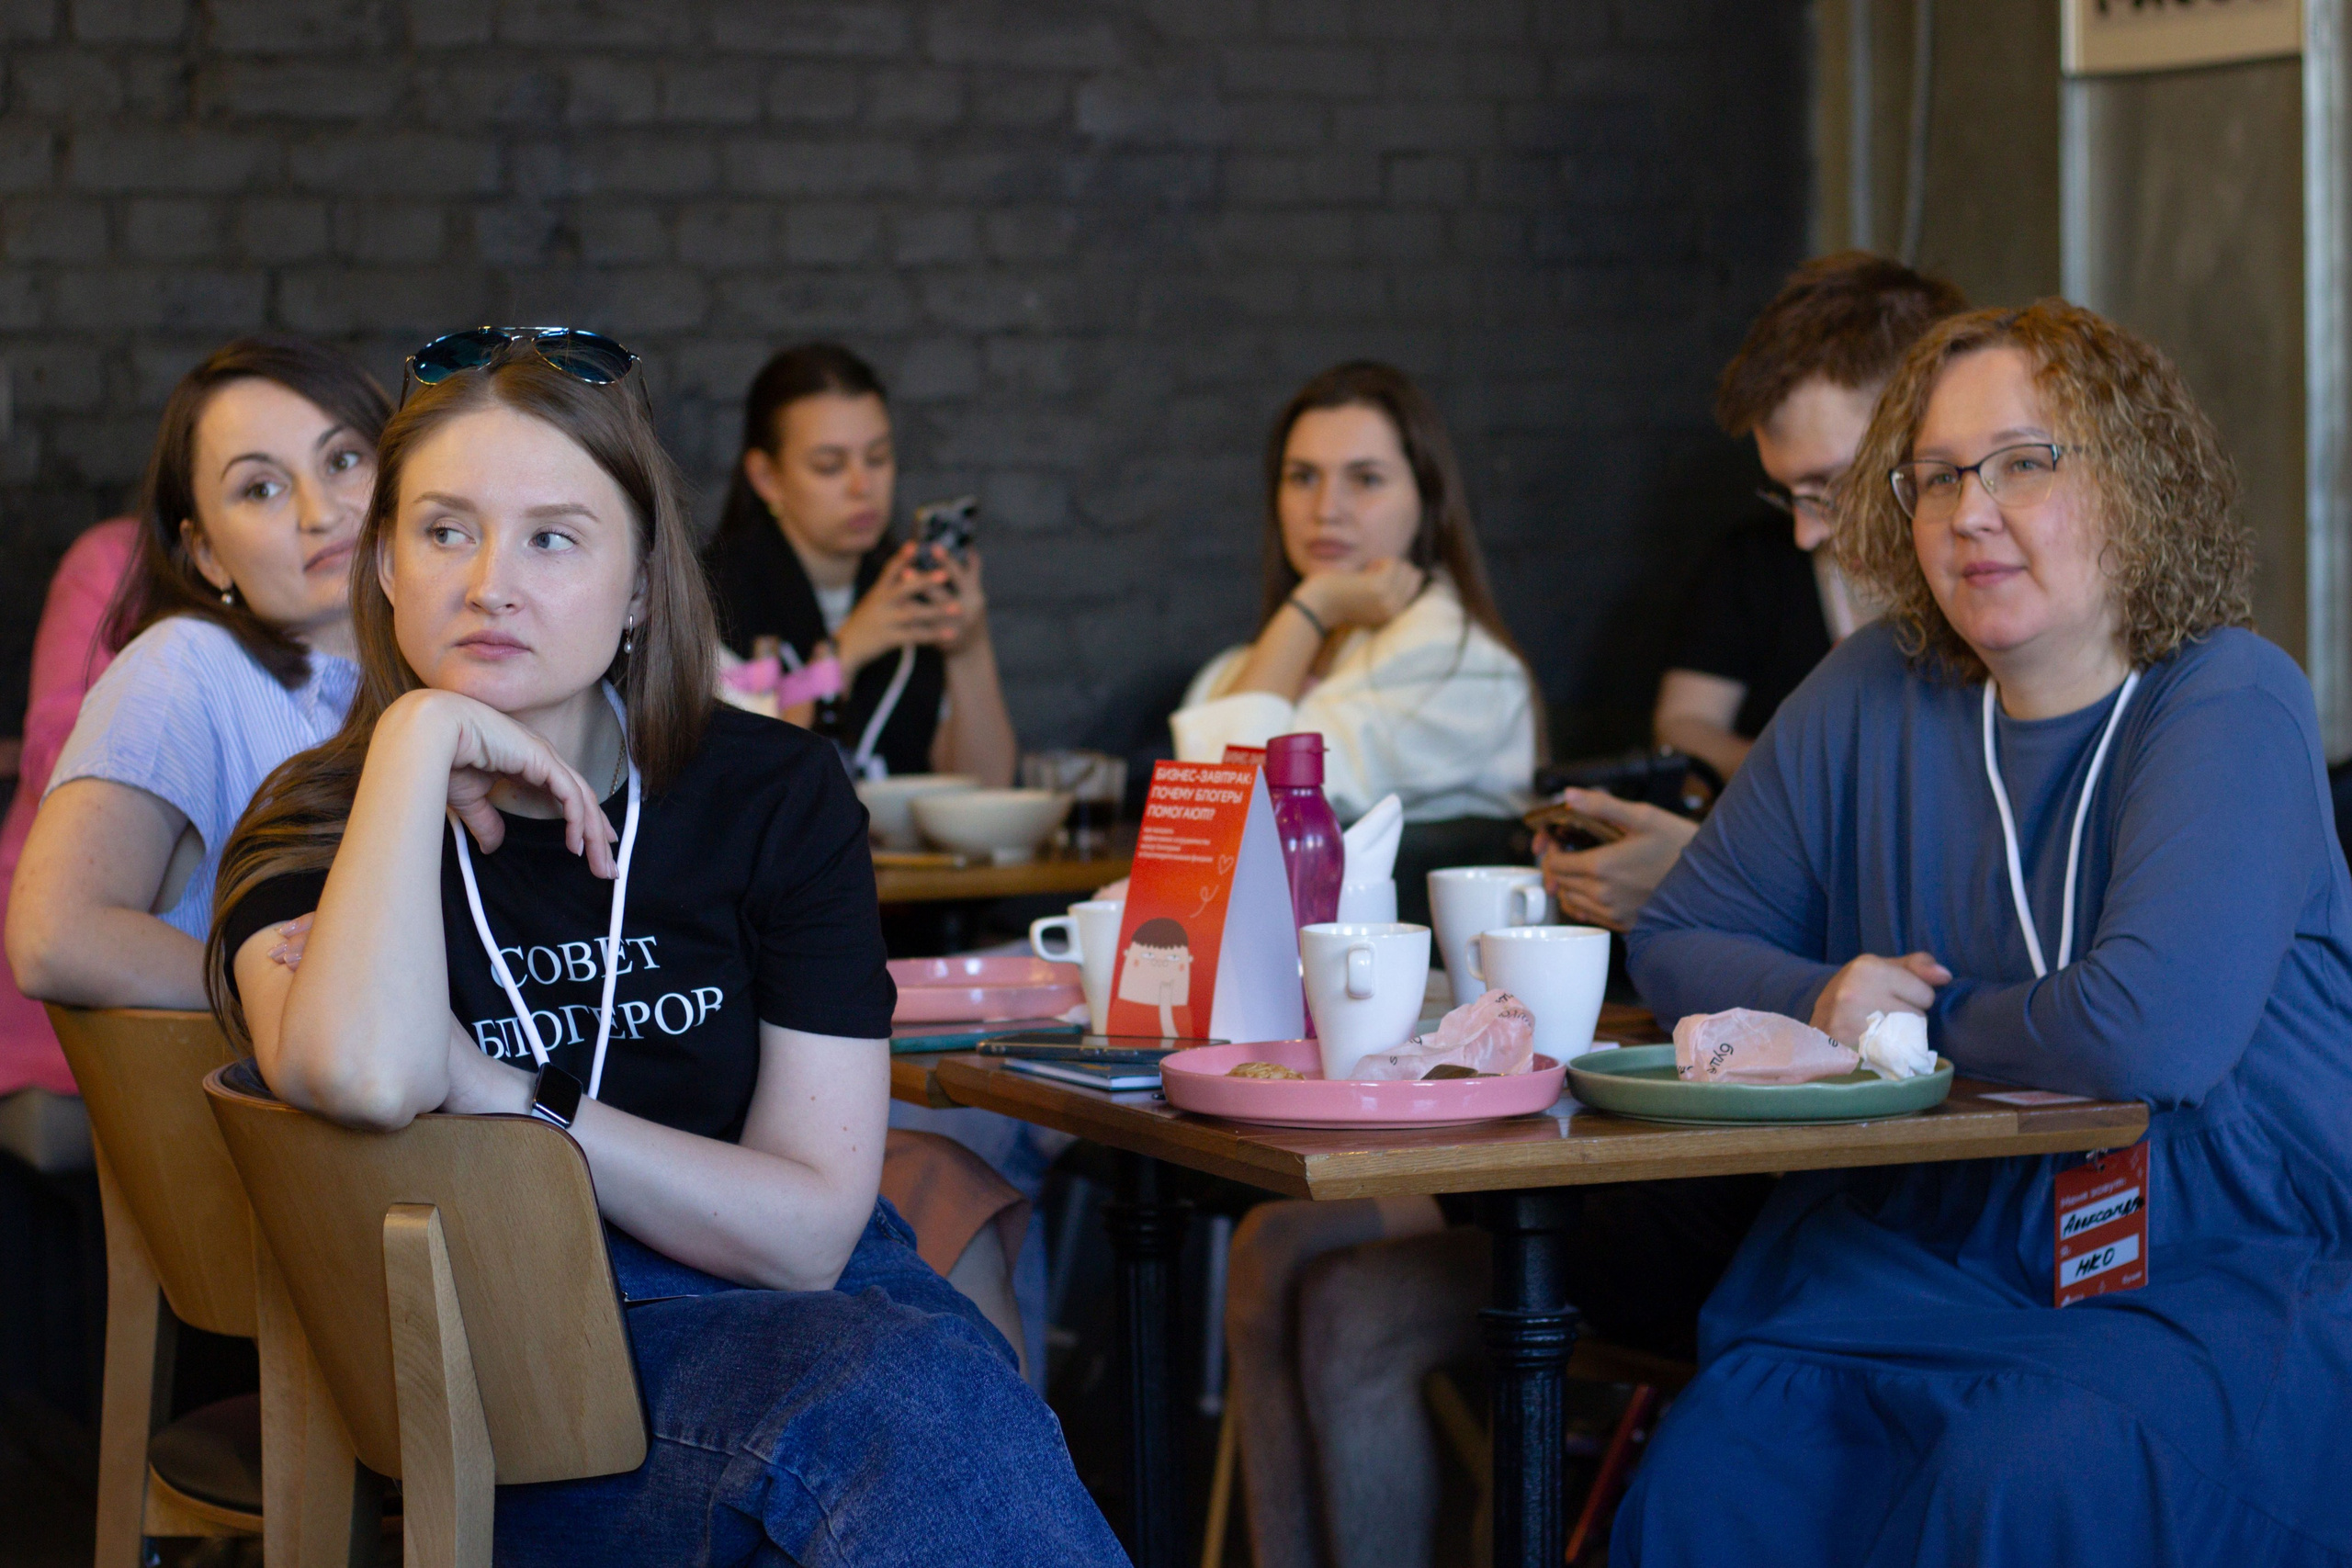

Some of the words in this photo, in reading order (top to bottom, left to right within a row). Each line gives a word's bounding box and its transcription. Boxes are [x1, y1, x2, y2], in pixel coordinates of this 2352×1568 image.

[1150, 785, 1194, 800] ПОЧЕМУ
[1194, 788, 1244, 804] БЛОГЕРЫ
[1146, 804, 1216, 821] ПОМОГАЮТ?
[491, 935, 661, 990] СОВЕТ
[2075, 1247, 2115, 1277] НКО
